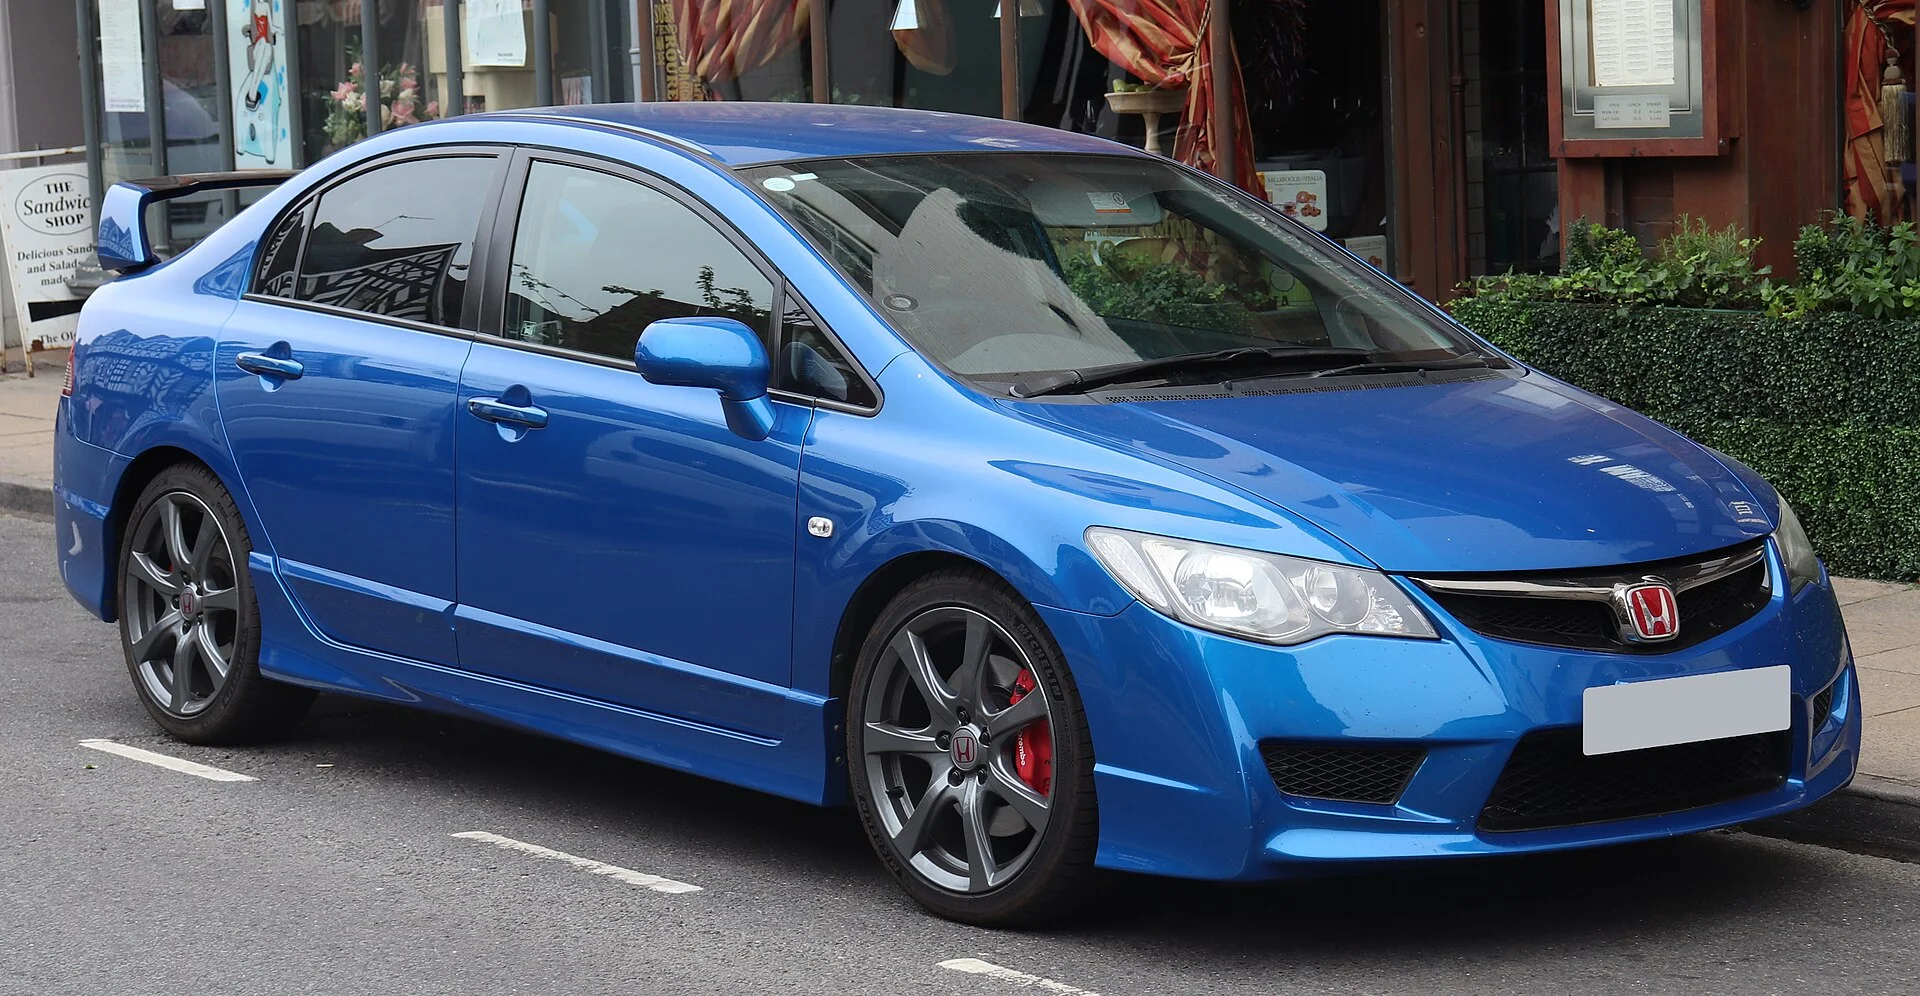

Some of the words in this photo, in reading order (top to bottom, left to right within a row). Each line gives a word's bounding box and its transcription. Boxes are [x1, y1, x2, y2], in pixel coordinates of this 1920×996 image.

[44, 181, 74, 194] THE
[23, 194, 91, 216] Sandwic
[45, 213, 84, 228] SHOP
[17, 248, 64, 261] Delicious
[67, 243, 95, 255] Sand
[27, 262, 46, 274] and
[38, 333, 58, 344] The
[1017, 622, 1063, 698] MICHELIN
